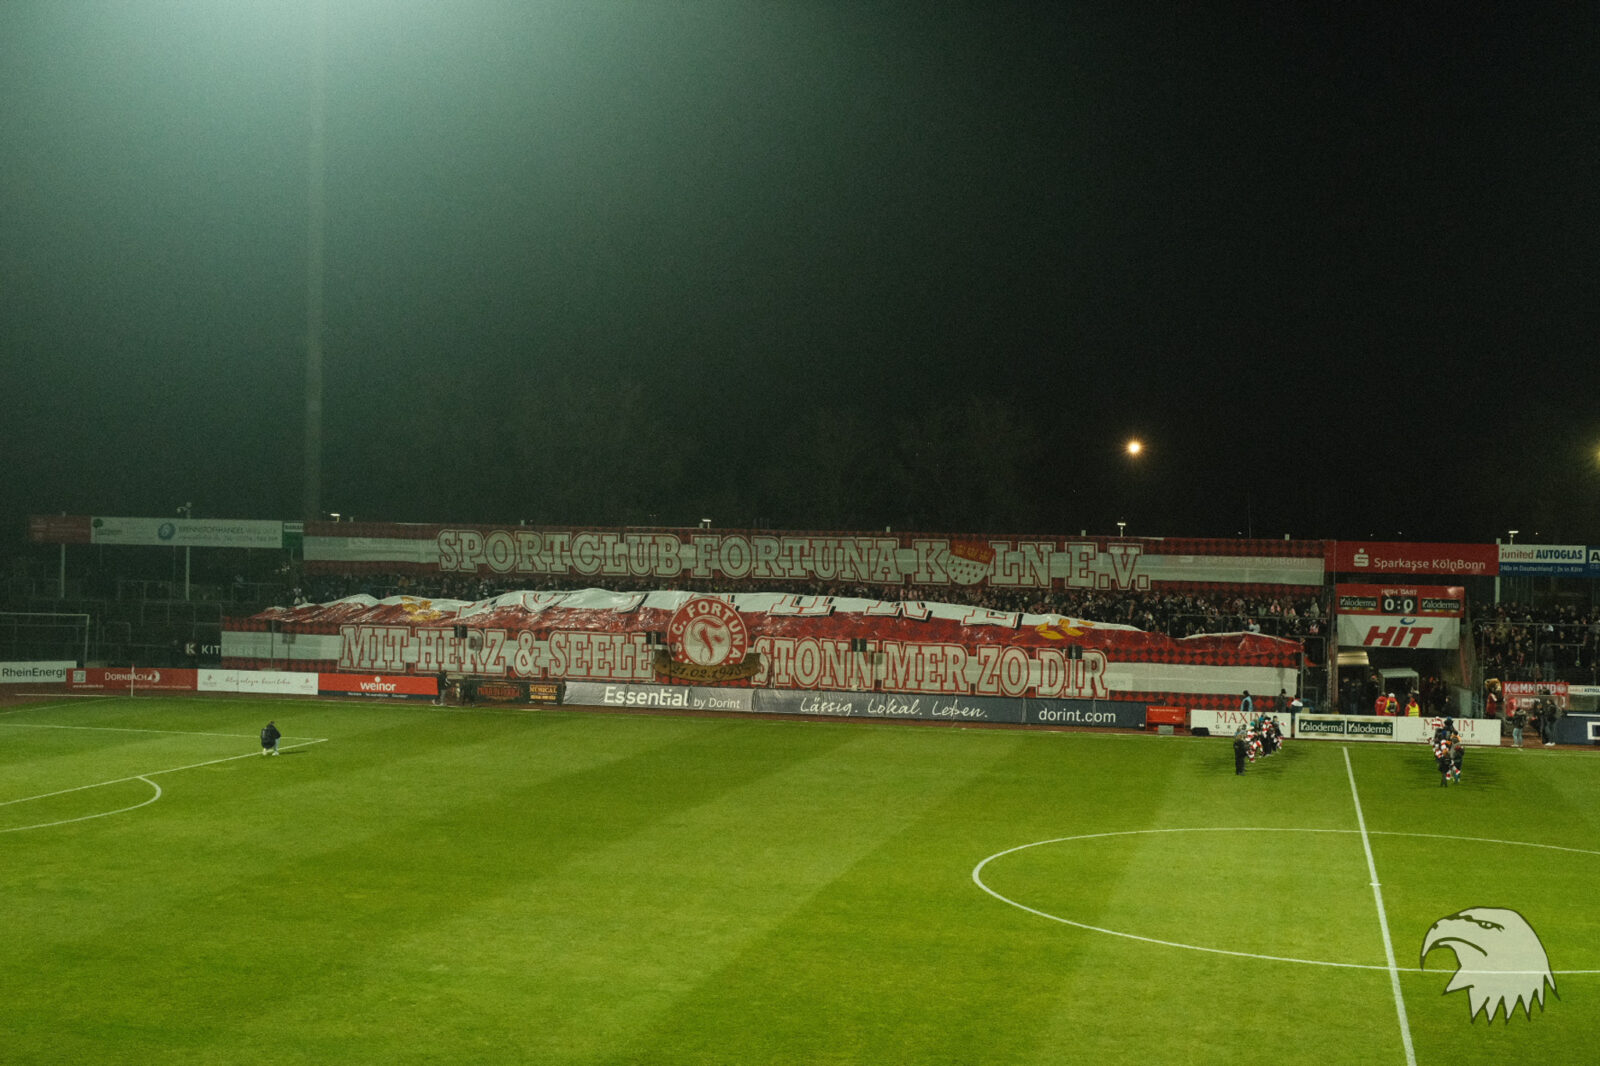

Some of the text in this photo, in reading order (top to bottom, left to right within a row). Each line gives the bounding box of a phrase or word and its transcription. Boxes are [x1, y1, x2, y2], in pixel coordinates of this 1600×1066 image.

[437, 529, 683, 577] SPORTCLUB
[691, 534, 904, 584] FORTUNA
[1065, 541, 1151, 590] E.V.
[1536, 549, 1583, 560] AUTOGLAS
[1374, 557, 1486, 570] Sparkasse KölnBonn
[1340, 598, 1377, 608] Kaloderma
[1422, 599, 1459, 609] Kaloderma
[686, 600, 745, 659] FORTUNA
[1362, 626, 1434, 647] HIT
[337, 625, 655, 681] MIT HERZ & SEELE
[751, 636, 1110, 700] STONN MER ZO DIR
[360, 677, 397, 691] weinor
[604, 686, 741, 709] Essential by Dorint
[800, 695, 988, 718] Lässig. Lokal. Leben.
[1038, 708, 1116, 723] dorint.com
[1300, 720, 1344, 732] Kaloderma
[1348, 722, 1392, 735] Kaloderma
[1423, 719, 1475, 732] MIM
